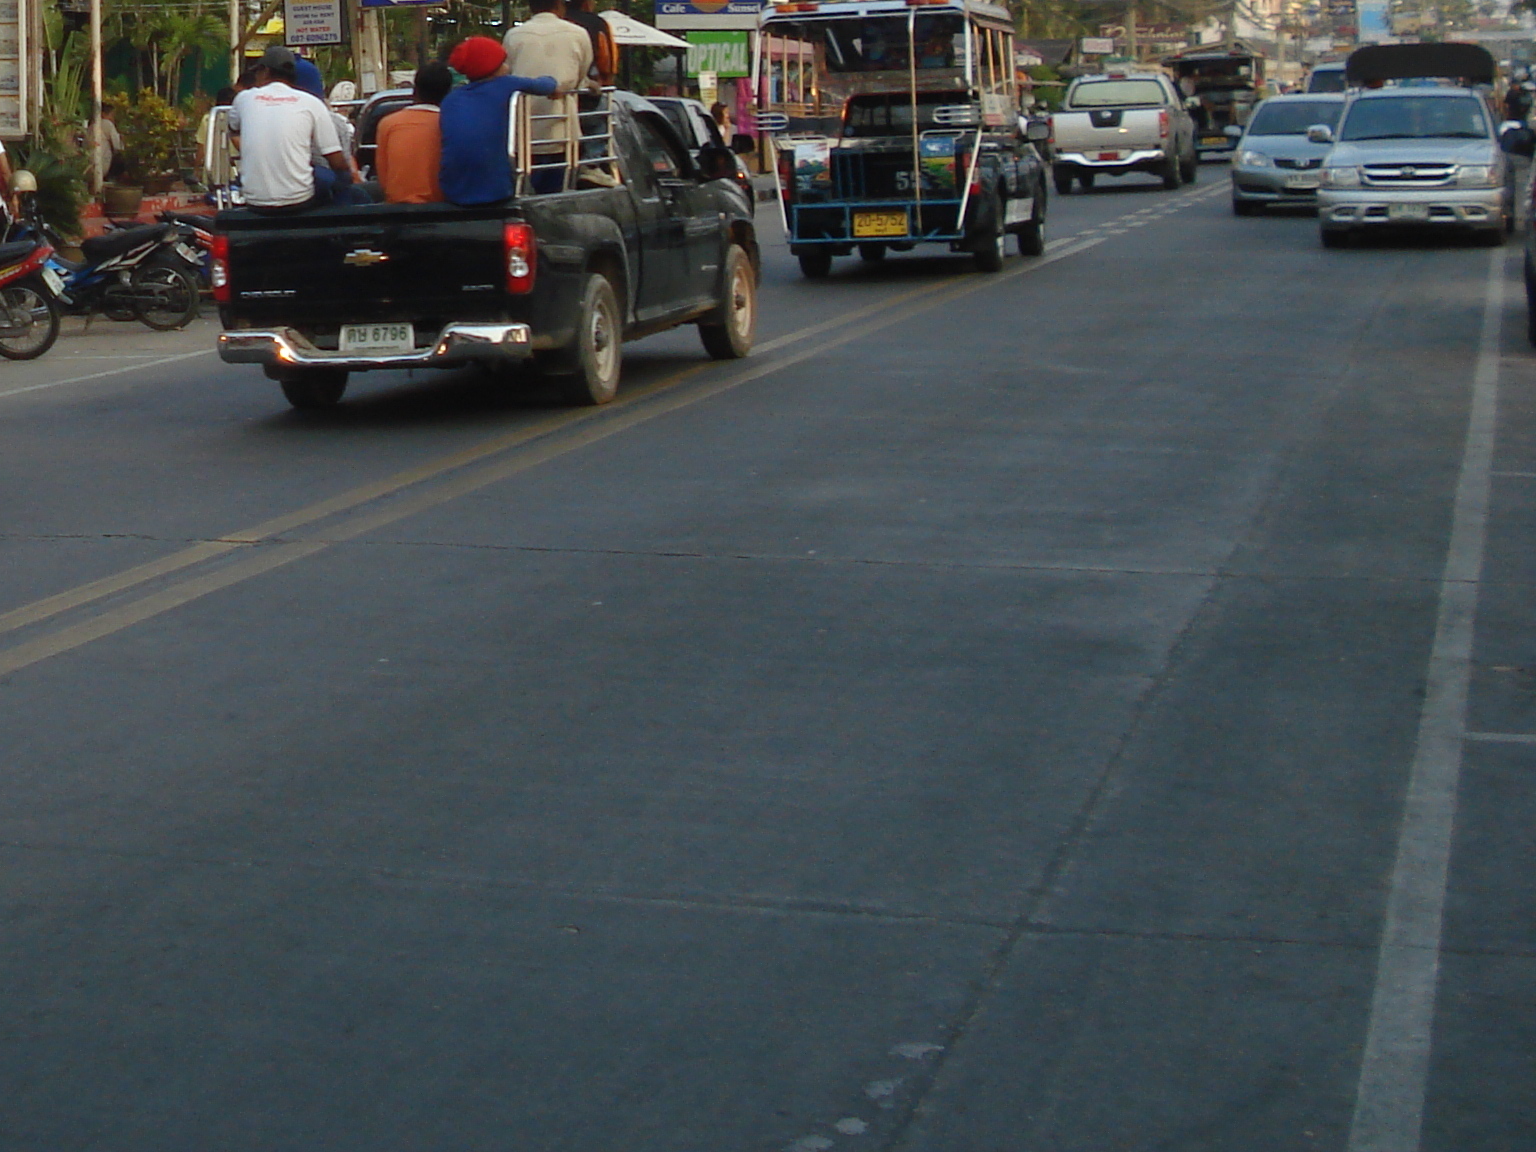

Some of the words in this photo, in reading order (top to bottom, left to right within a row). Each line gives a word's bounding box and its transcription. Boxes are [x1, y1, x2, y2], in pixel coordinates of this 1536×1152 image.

[661, 3, 686, 14] Cafe
[687, 41, 749, 74] OPTICAL
[372, 327, 407, 341] 6796
